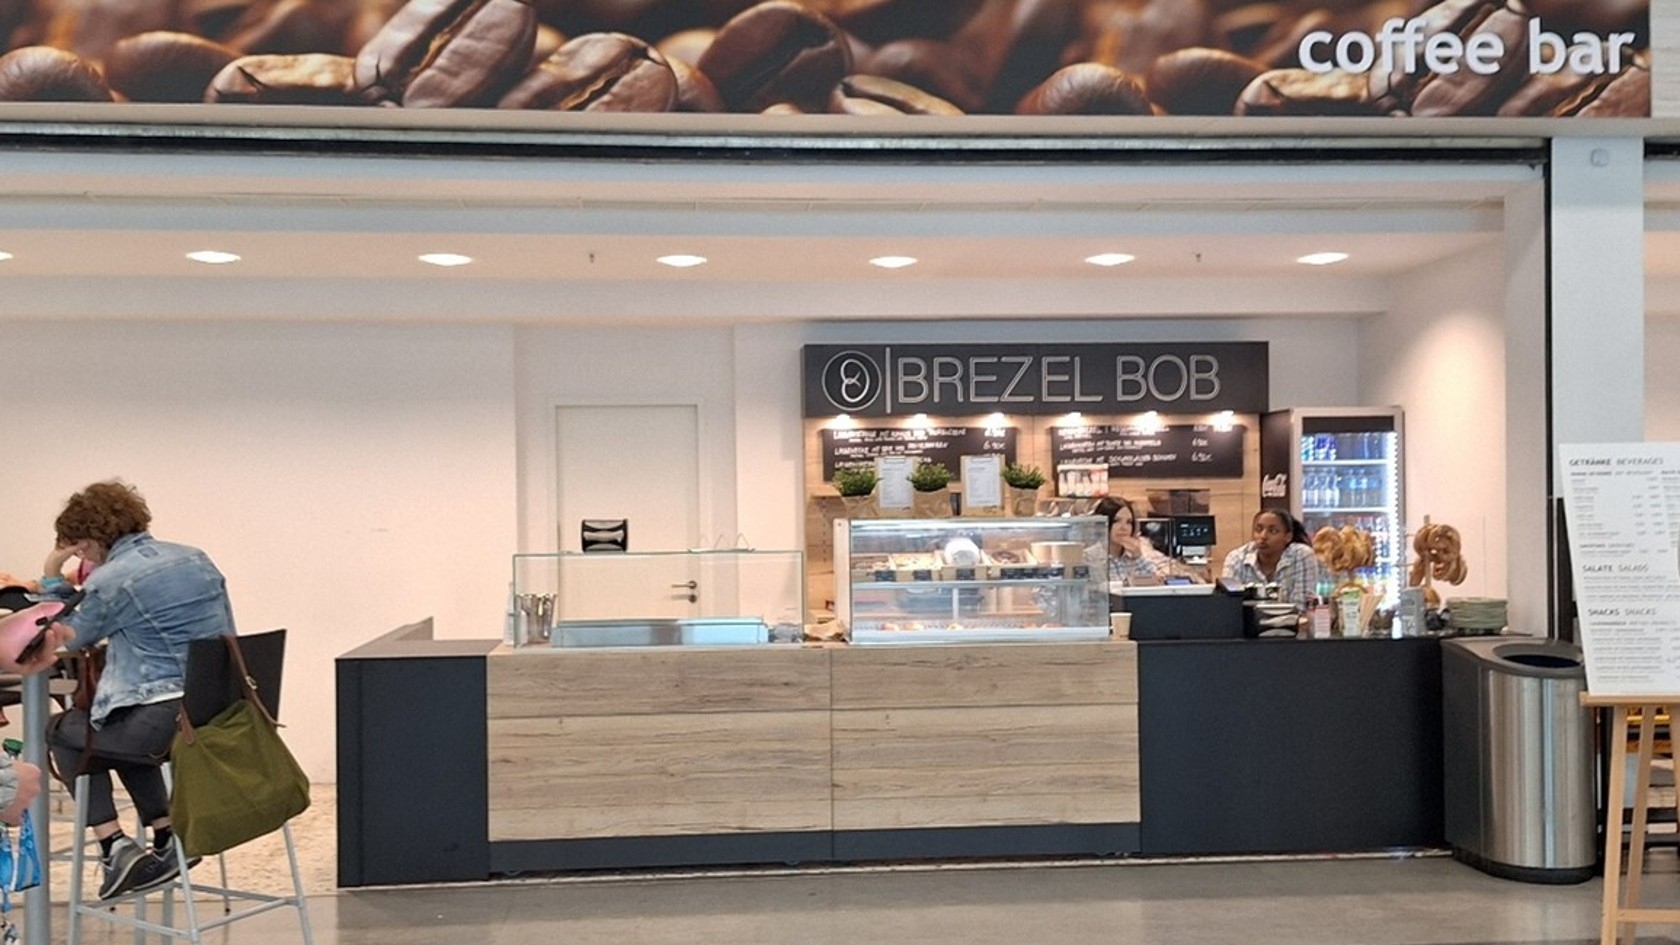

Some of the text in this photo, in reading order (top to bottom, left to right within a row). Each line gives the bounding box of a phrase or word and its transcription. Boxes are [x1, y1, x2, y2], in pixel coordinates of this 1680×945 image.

[1298, 17, 1636, 75] coffee bar
[898, 354, 1221, 404] BREZEL BOB
[1616, 457, 1665, 466] BEVERAGES
[1583, 564, 1614, 573] SALATE
[1587, 607, 1658, 617] SNACKS SNACKS
